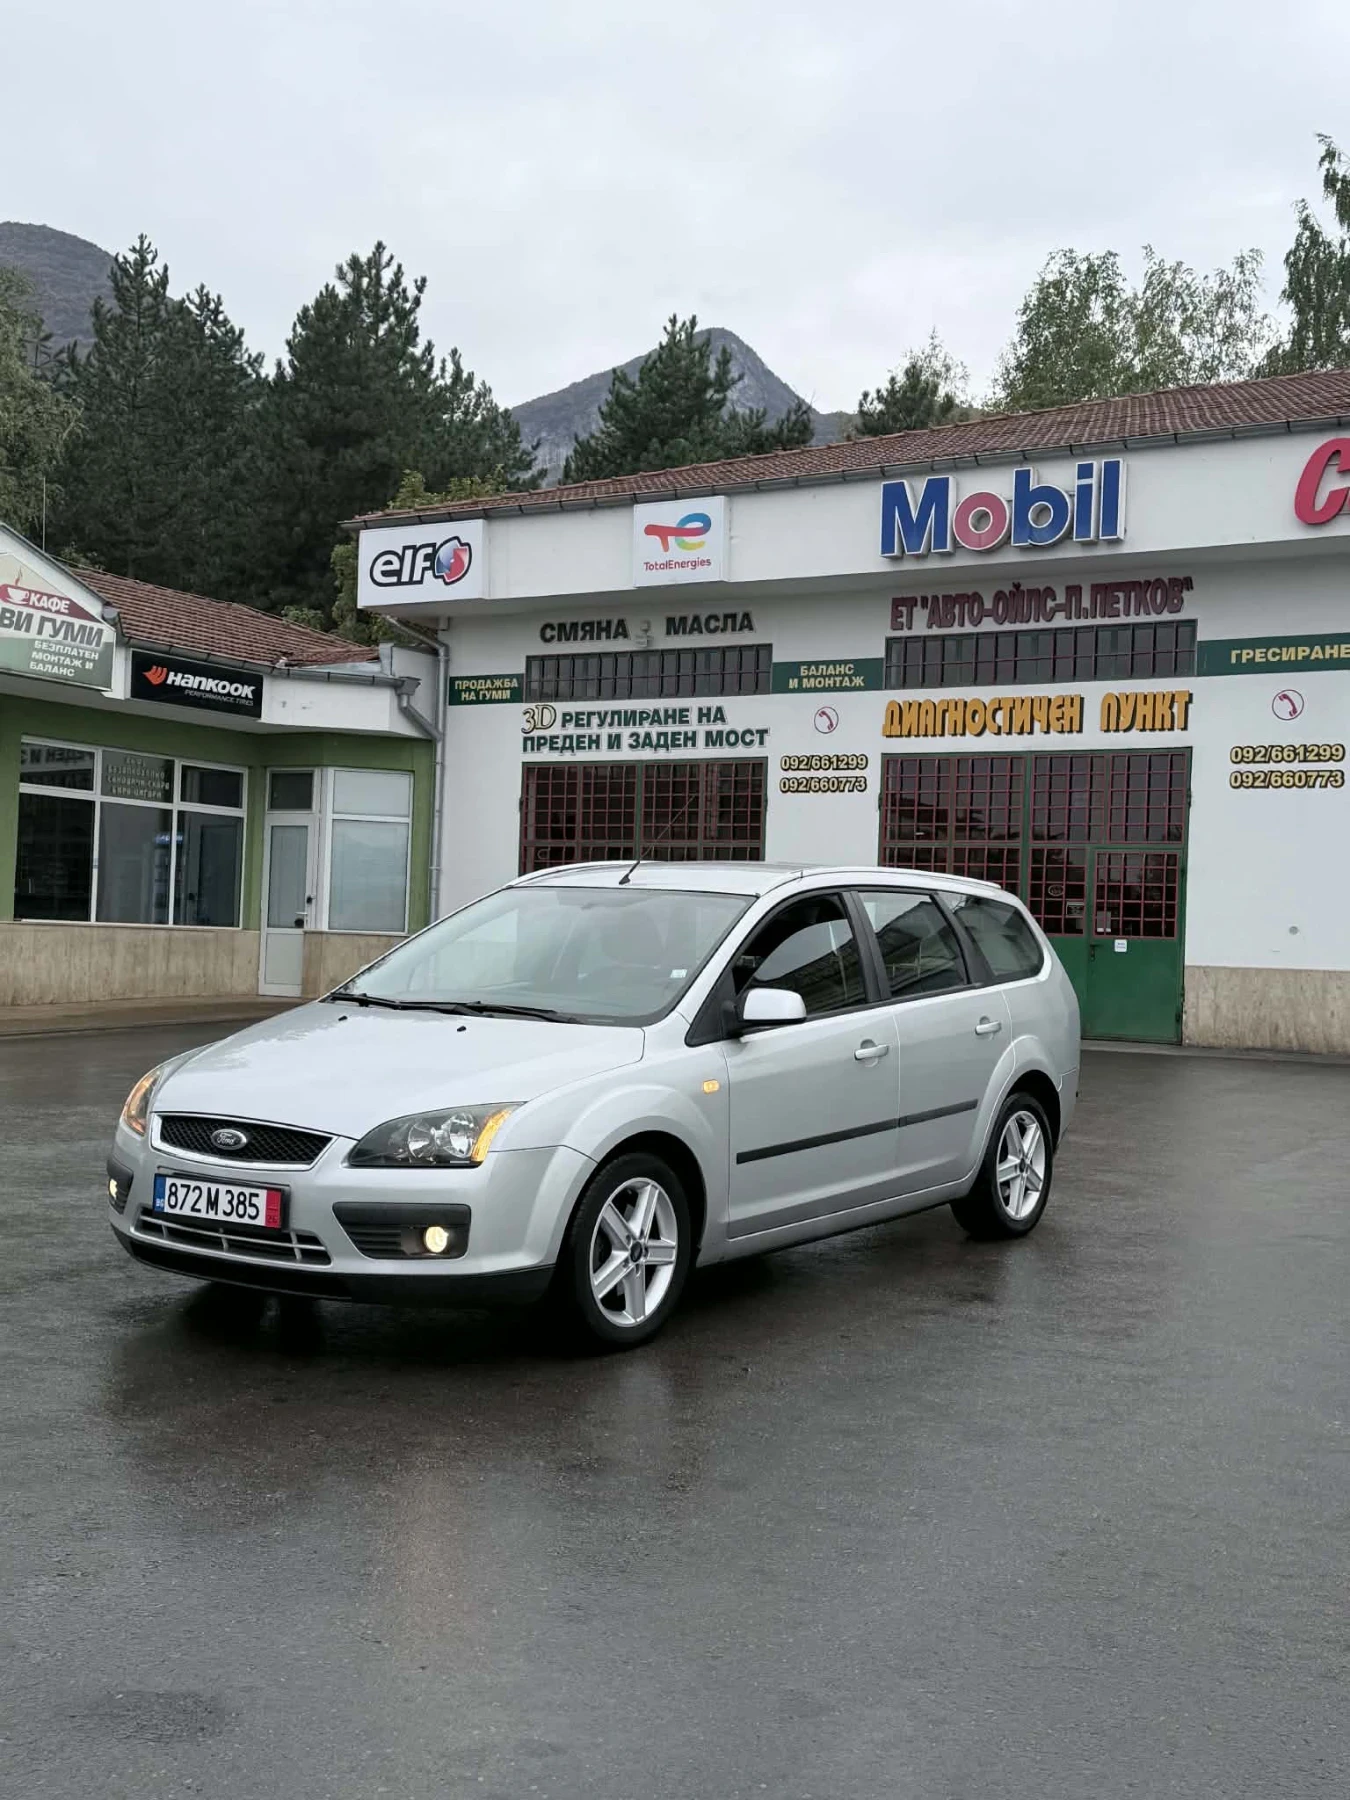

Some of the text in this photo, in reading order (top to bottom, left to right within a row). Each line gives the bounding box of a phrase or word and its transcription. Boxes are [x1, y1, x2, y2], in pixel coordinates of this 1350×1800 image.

[880, 459, 1124, 557] Mobil
[370, 543, 437, 587] elf
[643, 557, 712, 571] TotalEnergies
[29, 592, 70, 613] КАФЕ
[891, 597, 918, 629] ЕТ
[36, 615, 104, 648] ГУМИ
[539, 611, 754, 643] СМЯНА МАСЛА
[34, 640, 99, 660] БЕЗПЛАТЕН
[1230, 644, 1350, 664] ГРЕСИРАНЕ
[29, 661, 75, 677] БАЛАНС
[31, 651, 94, 670] МОНТАЖ И
[800, 664, 854, 676] БАЛАНС
[455, 678, 518, 691] ПРОДАЖБА
[788, 676, 865, 689] И МОНТАЖ
[461, 689, 511, 700] НА ГУМИ
[521, 704, 728, 734] 3D РЕГУЛИРАНЕ НА
[882, 690, 1193, 738] ДИАГНОСТИЧЕН ПУНКТ
[522, 727, 769, 755] ПРЕДЕН И ЗАДЕН МОСТ
[780, 754, 869, 771] 092/661299
[1230, 744, 1346, 764] 092/661299
[779, 776, 868, 793] 092/660773
[1229, 769, 1345, 788] 092/660773
[217, 1131, 237, 1145] Ford
